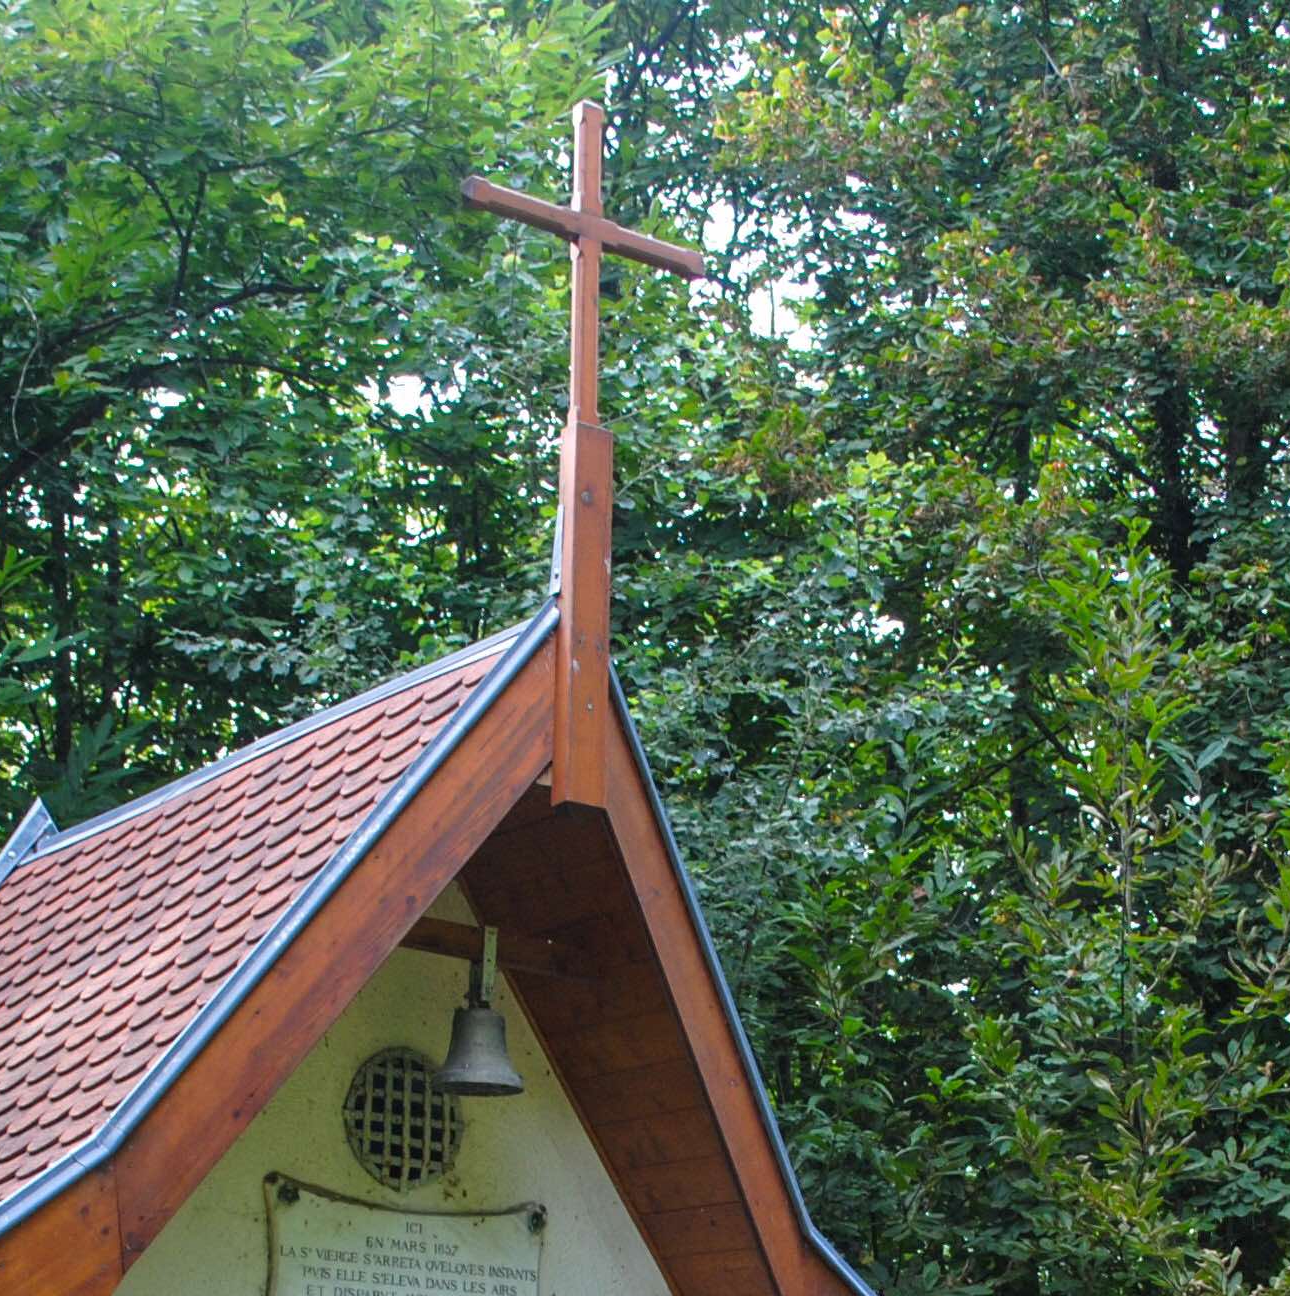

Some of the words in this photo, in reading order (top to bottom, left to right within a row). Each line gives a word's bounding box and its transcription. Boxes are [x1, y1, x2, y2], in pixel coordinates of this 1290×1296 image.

[405, 1222, 423, 1234] ICI
[389, 1240, 427, 1253] MARS
[280, 1246, 297, 1258] LA
[315, 1248, 358, 1263] VIERGE
[487, 1266, 537, 1282] INSTANTS
[336, 1270, 366, 1282] ELLE
[425, 1278, 458, 1291] DANS
[462, 1280, 486, 1294] LES
[491, 1285, 518, 1296] AIRS
[306, 1285, 325, 1296] ET
